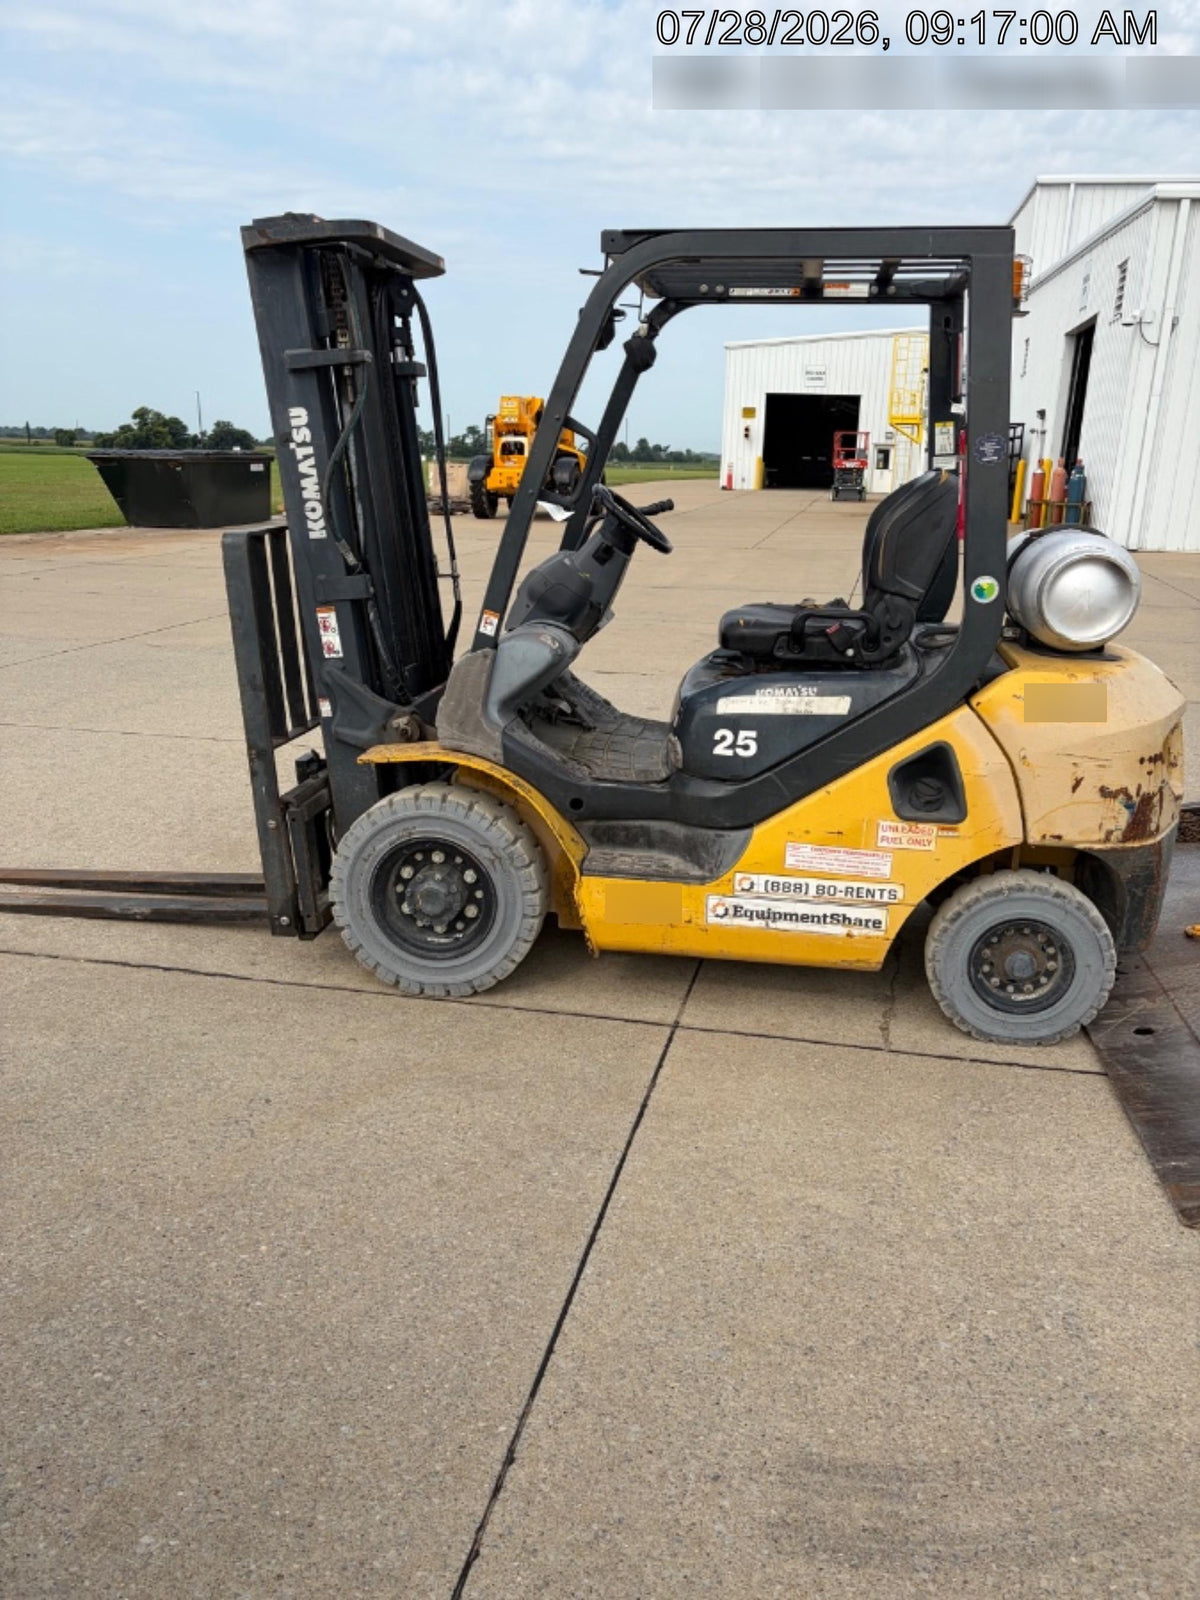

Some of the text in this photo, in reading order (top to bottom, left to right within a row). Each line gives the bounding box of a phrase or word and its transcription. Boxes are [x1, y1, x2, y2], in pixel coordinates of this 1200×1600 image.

[288, 406, 328, 540] KOMATSU
[712, 728, 758, 757] 25
[880, 835, 933, 847] FUEL ONLY
[881, 823, 935, 836] UNLEADED
[764, 879, 898, 901] (888) 80-RENTS
[732, 905, 882, 929] EquipmentShare
